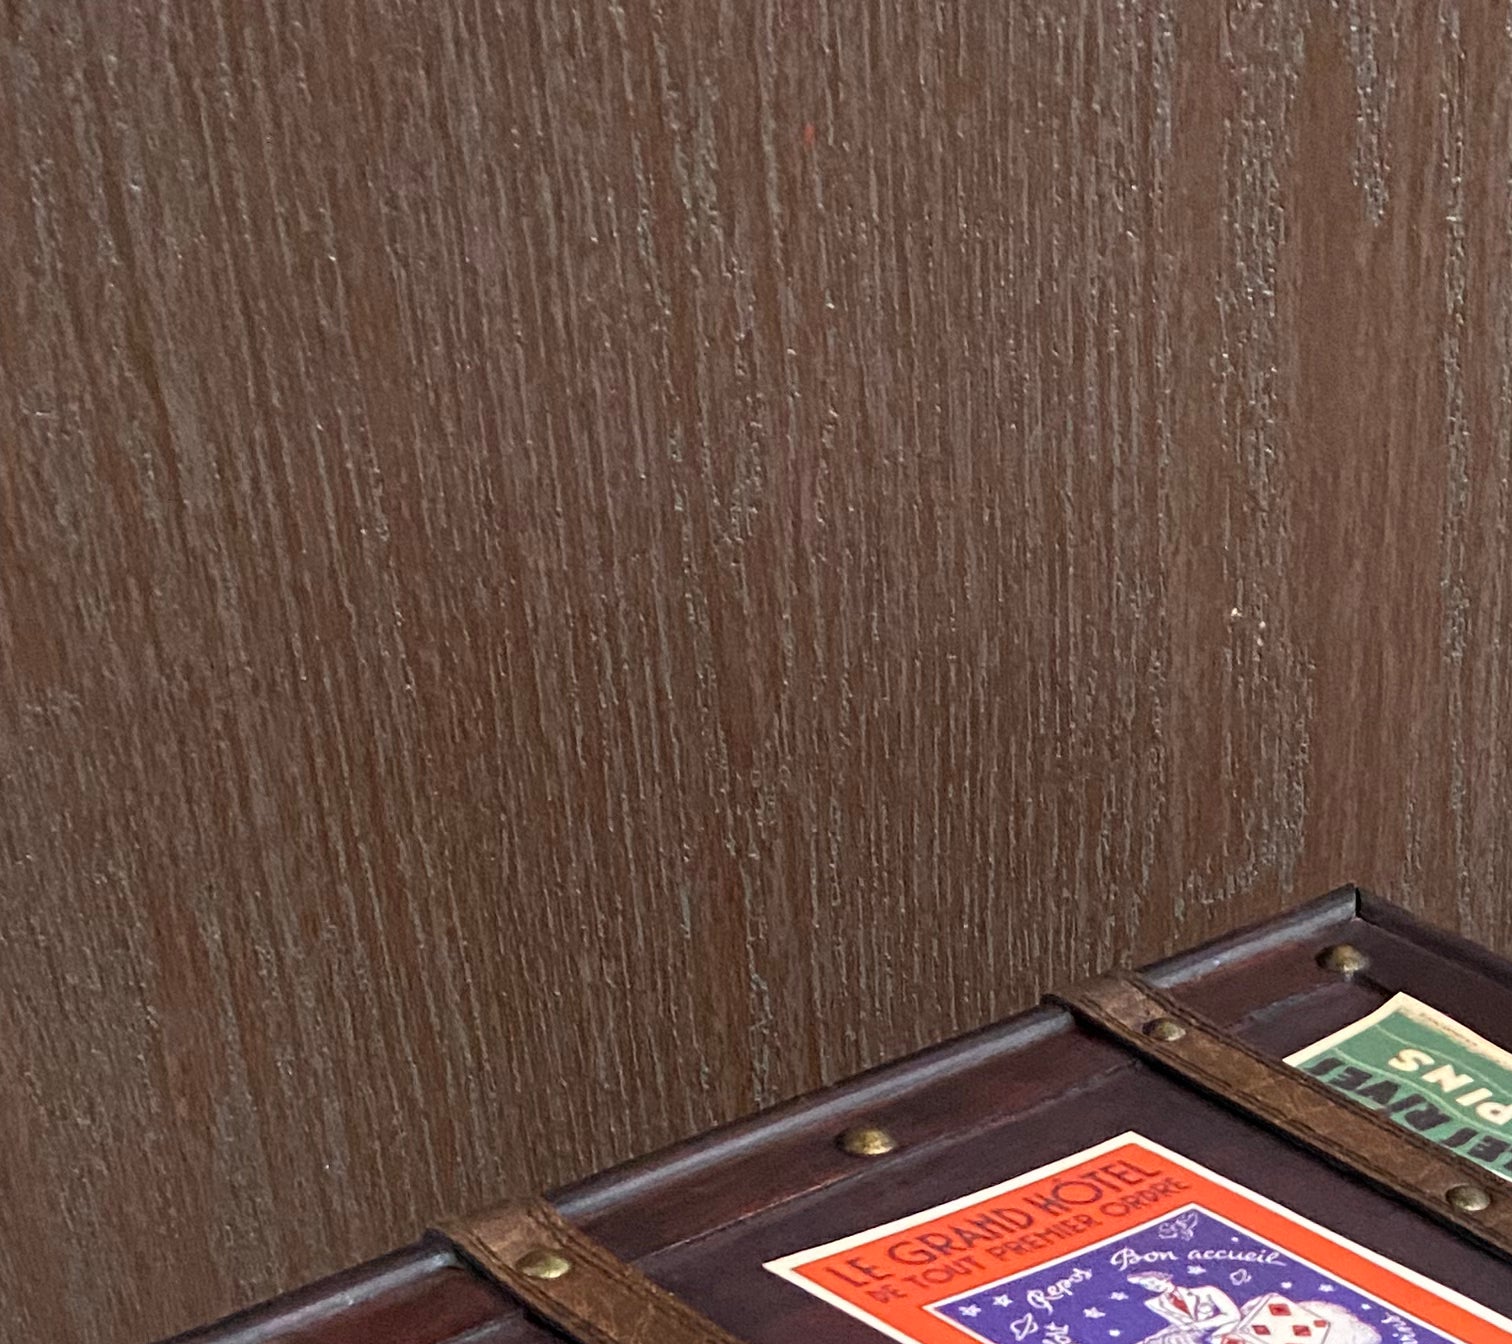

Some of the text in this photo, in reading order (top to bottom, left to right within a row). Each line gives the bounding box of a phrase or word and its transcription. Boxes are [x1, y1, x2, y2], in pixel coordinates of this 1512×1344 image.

[825, 1258, 896, 1289] LE
[888, 1206, 1034, 1266] GRAND
[864, 1176, 1193, 1305] DE TOUT PREMIER ORDRE
[1110, 1246, 1287, 1271] Bon accueil
[1026, 1268, 1093, 1315] Repos
